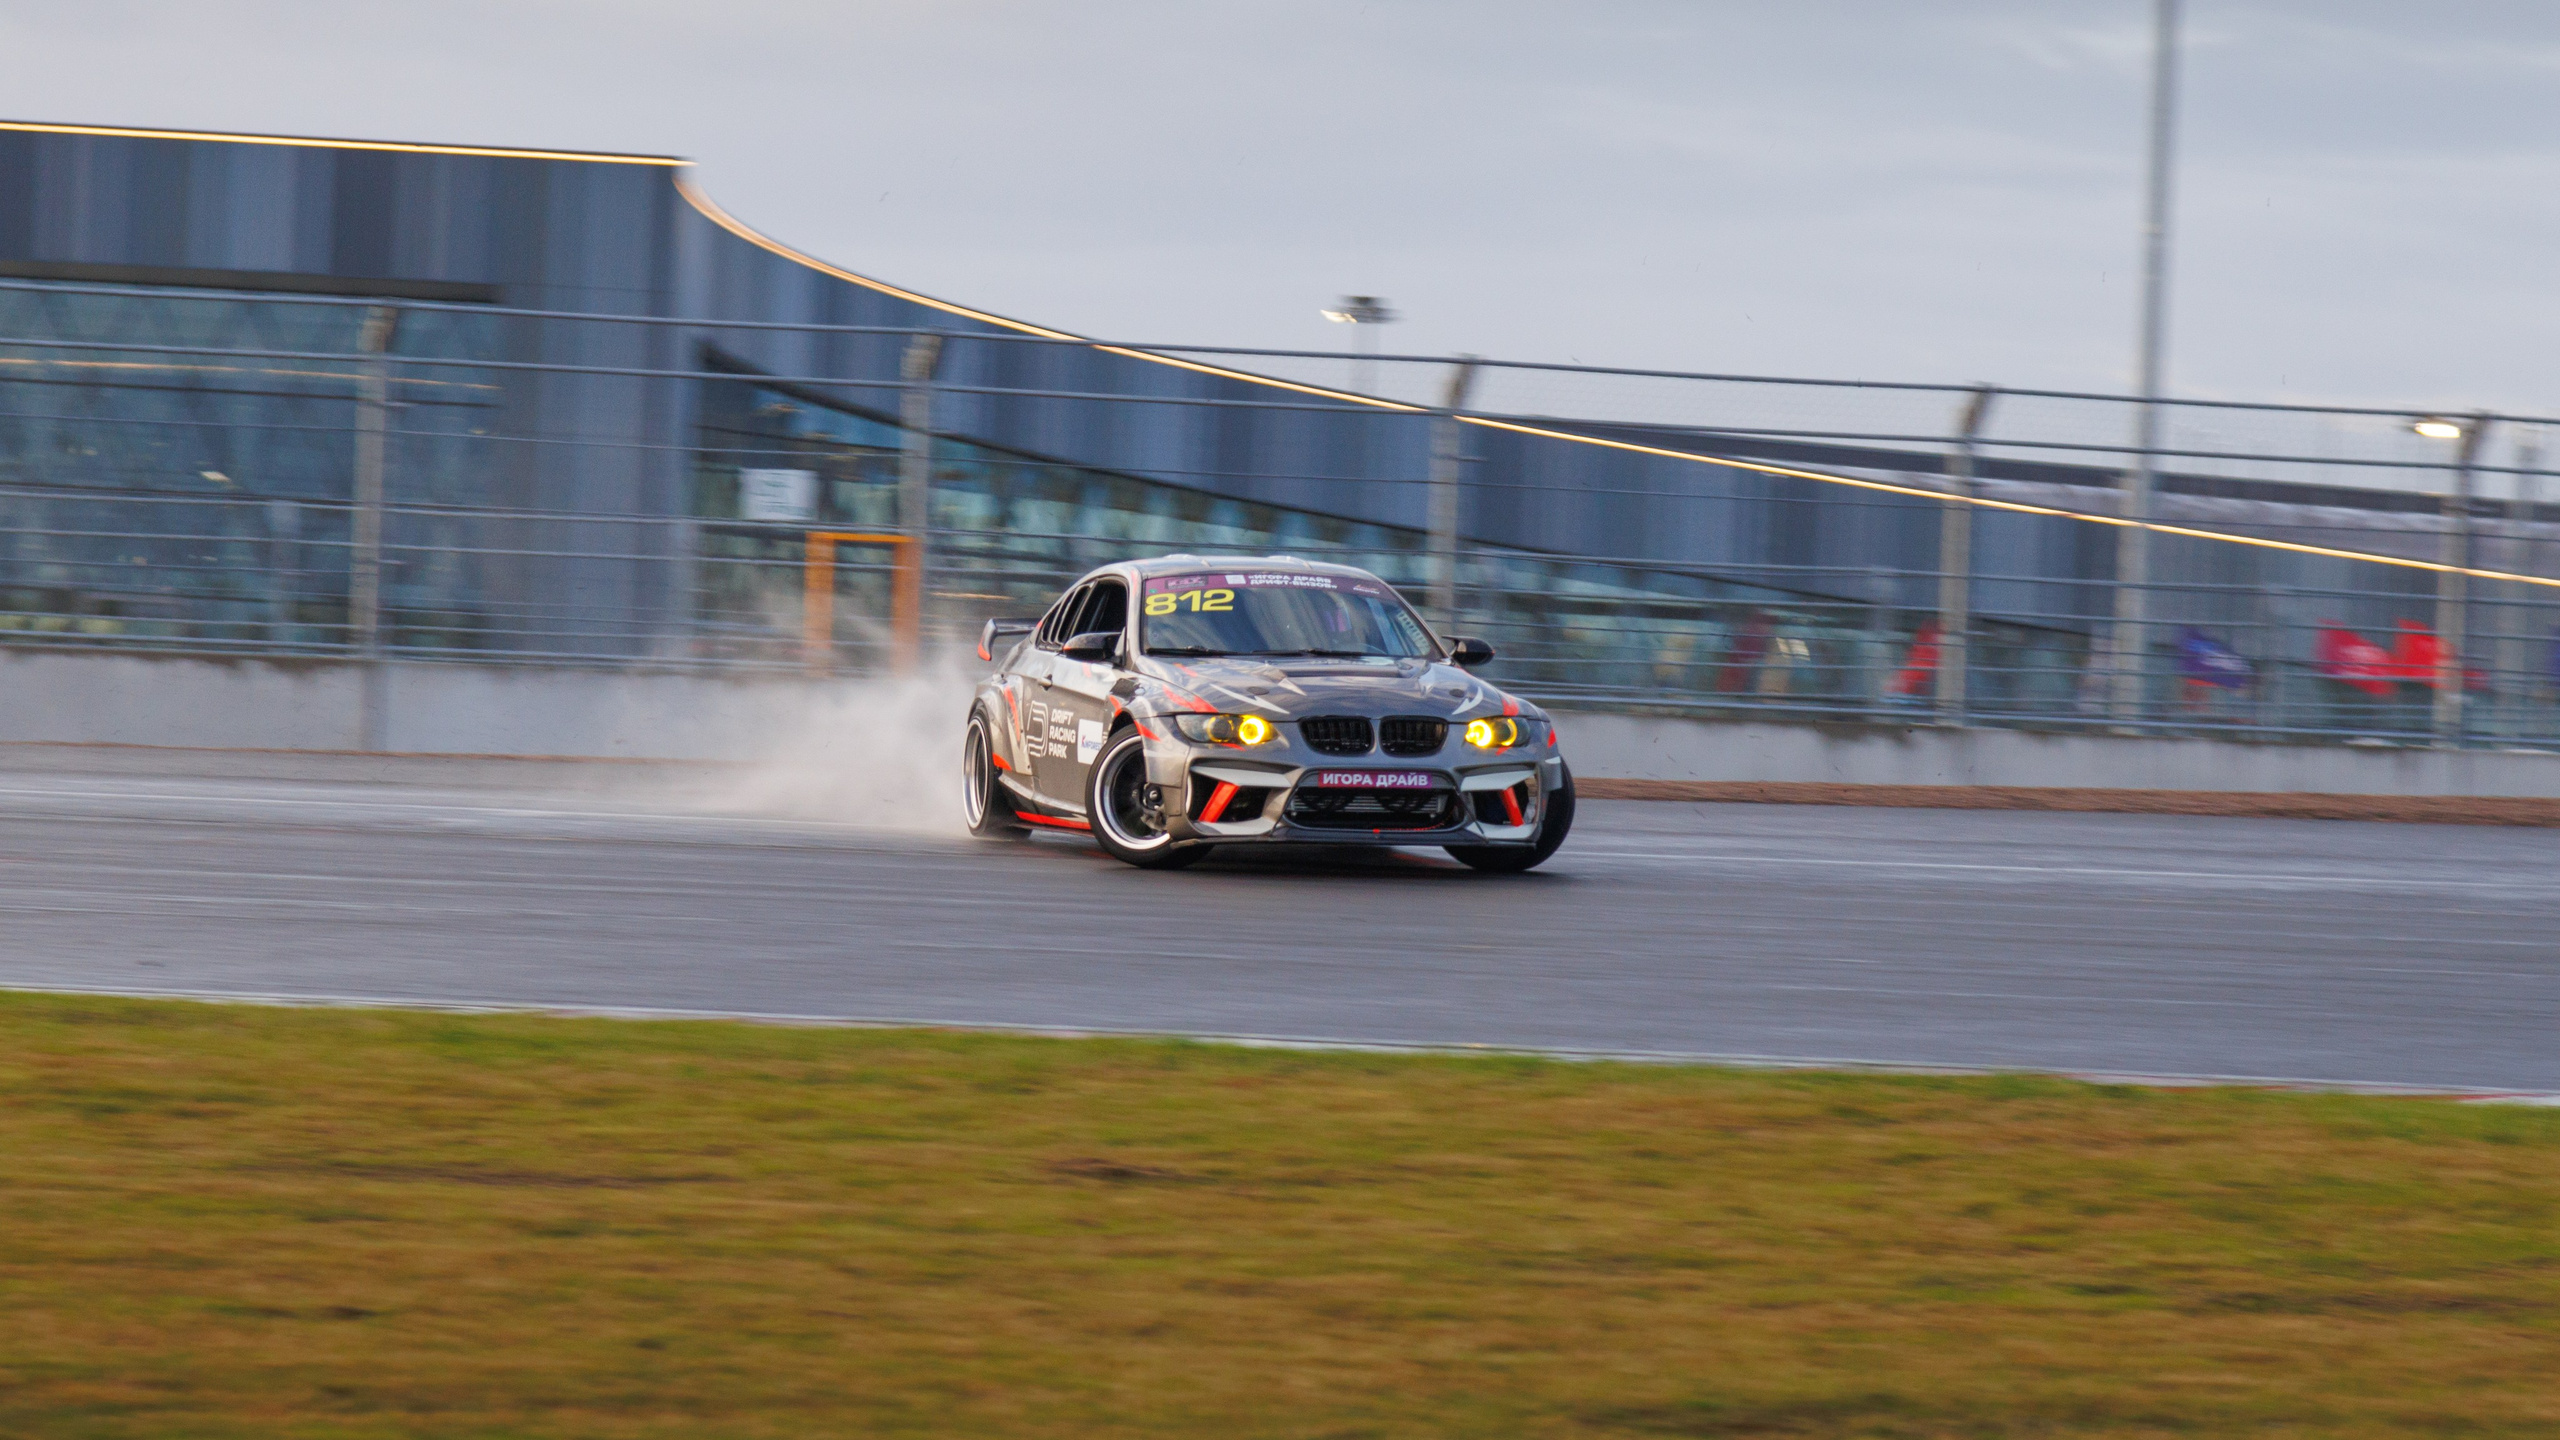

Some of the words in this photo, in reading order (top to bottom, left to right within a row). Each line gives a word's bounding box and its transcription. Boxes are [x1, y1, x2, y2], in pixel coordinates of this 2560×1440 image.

[1145, 588, 1235, 616] 812
[1051, 709, 1074, 725] DRIFT
[1049, 725, 1076, 743] RACING
[1048, 742, 1067, 759] PARK
[1322, 773, 1373, 785] ИГОРА
[1376, 772, 1428, 787] ДРАЙВ
